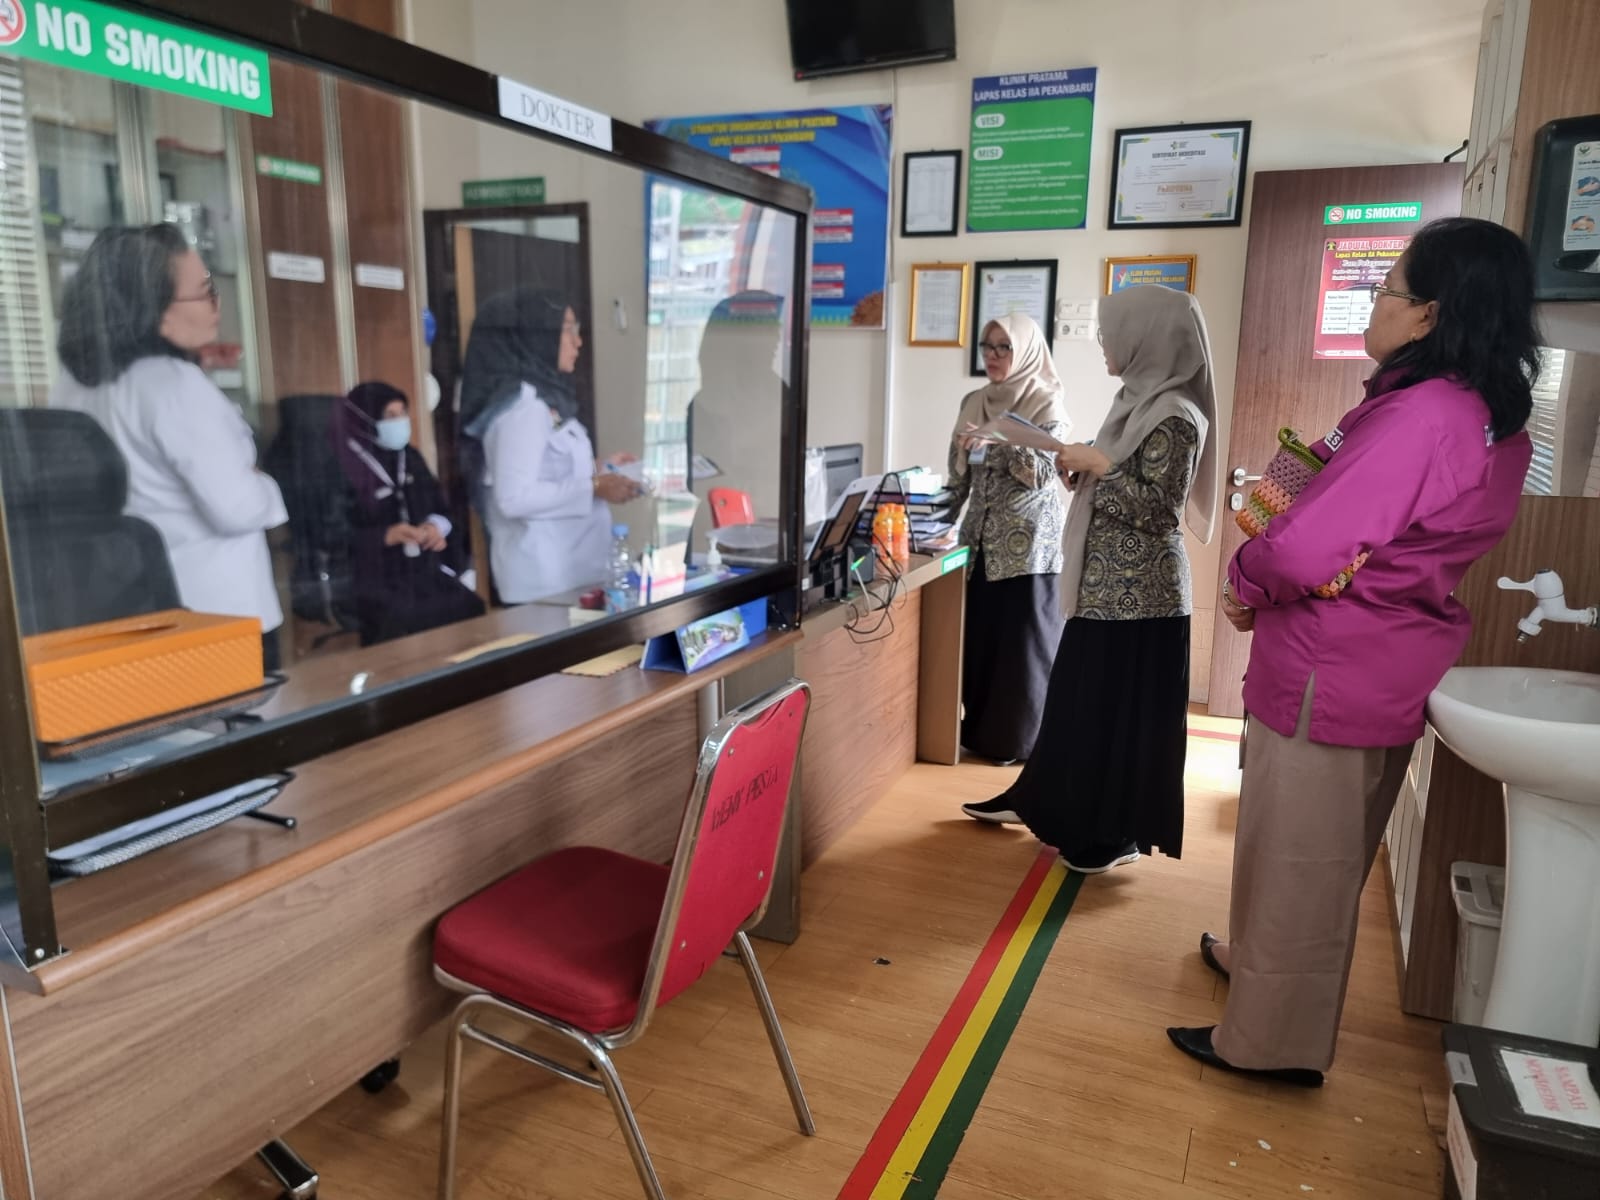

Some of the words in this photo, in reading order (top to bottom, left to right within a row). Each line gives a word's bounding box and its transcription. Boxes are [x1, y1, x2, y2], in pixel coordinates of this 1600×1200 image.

[37, 2, 91, 55] NO
[105, 24, 261, 100] SMOKING
[1000, 75, 1026, 86] KLINIK
[1028, 71, 1068, 84] PRATAMA
[974, 91, 1000, 102] LAPAS
[1001, 89, 1027, 100] KELAS
[1041, 83, 1093, 96] PEKANBARU
[520, 92, 596, 141] DOKTER
[980, 115, 1001, 126] VISI
[978, 148, 1000, 158] MISI
[1346, 208, 1362, 220] NO
[1366, 206, 1417, 219] SMOKING
[1337, 240, 1371, 250] JADWAL
[1372, 240, 1404, 249] DOKTER
